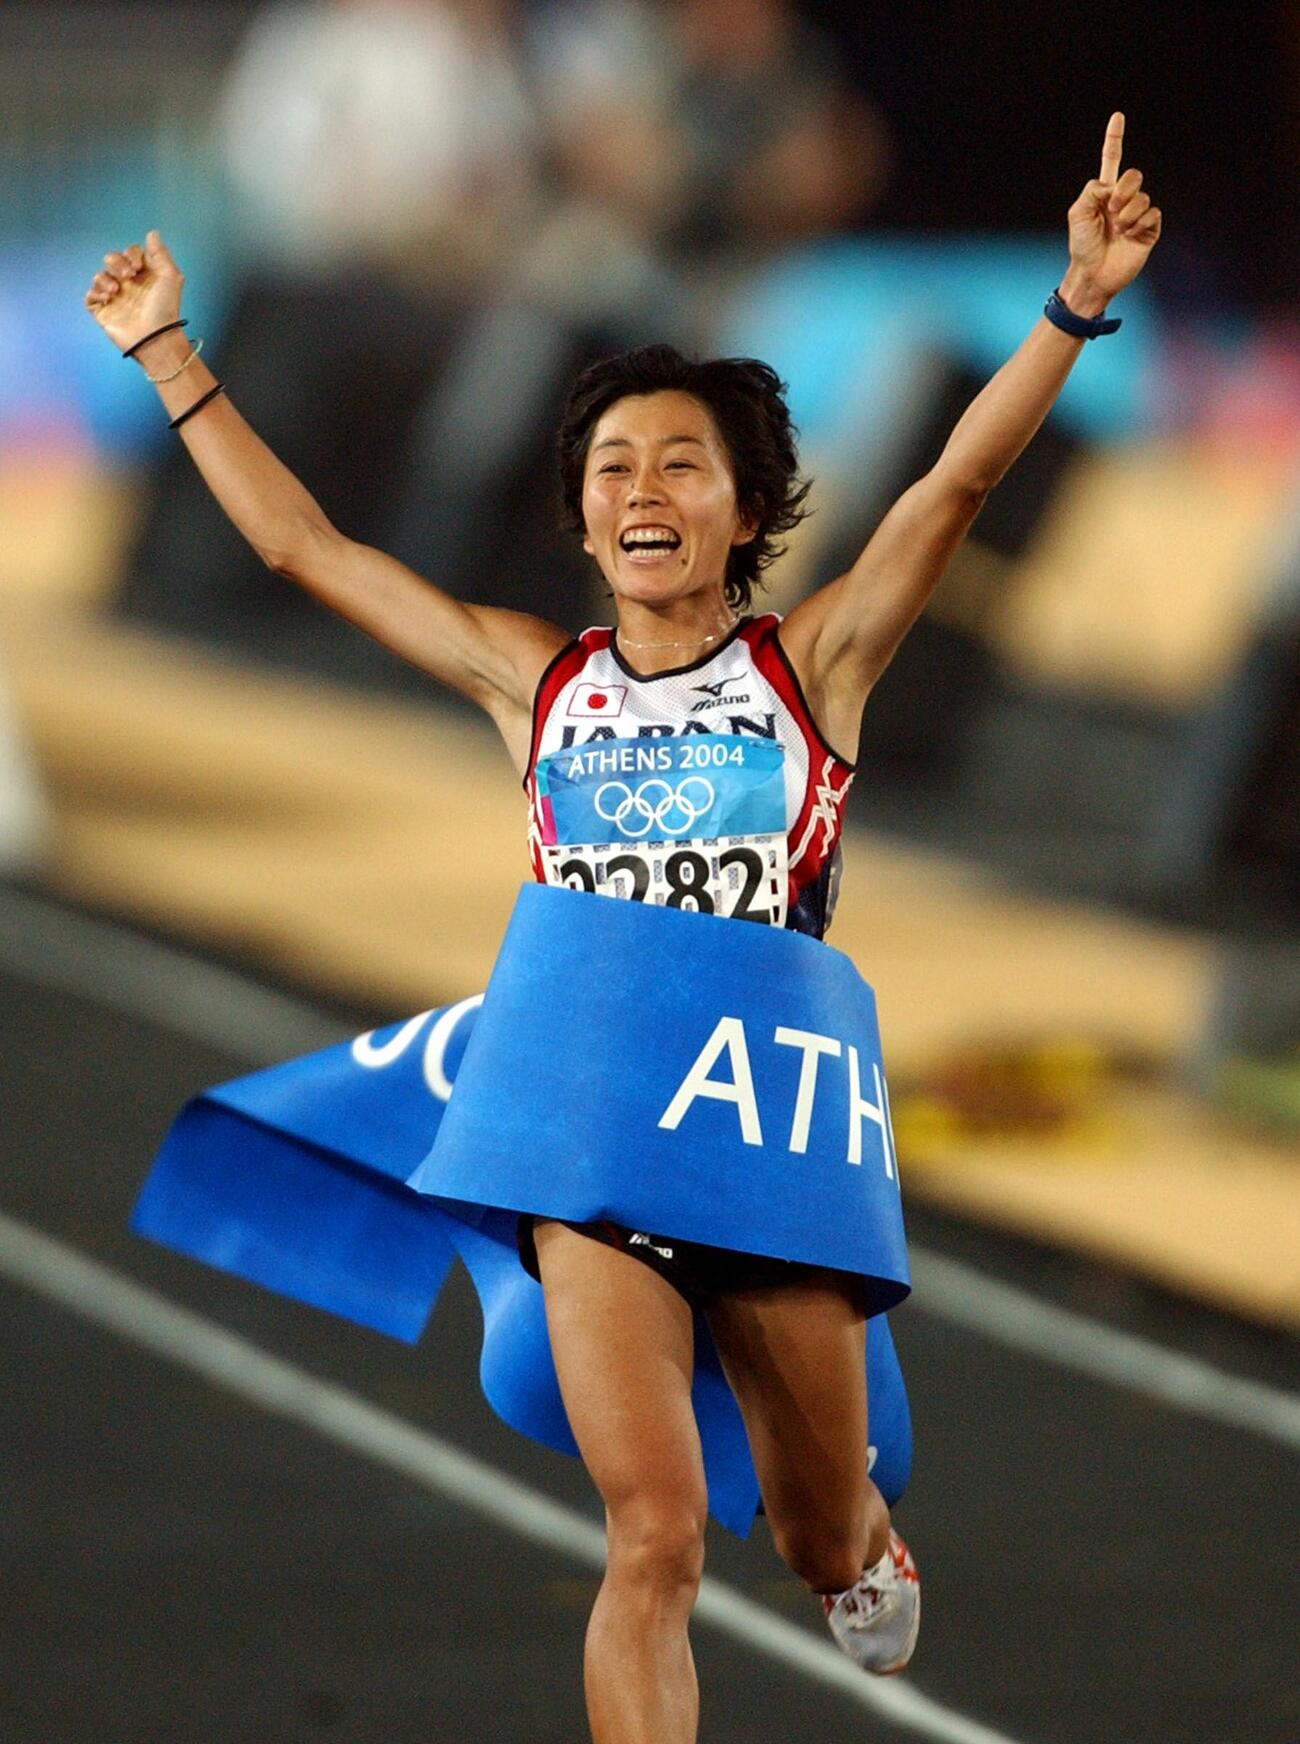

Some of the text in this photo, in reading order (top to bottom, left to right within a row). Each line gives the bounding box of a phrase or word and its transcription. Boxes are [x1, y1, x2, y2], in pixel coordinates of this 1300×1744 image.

[568, 743, 745, 779] ATHENS 2004
[658, 1016, 900, 1191] ATH
